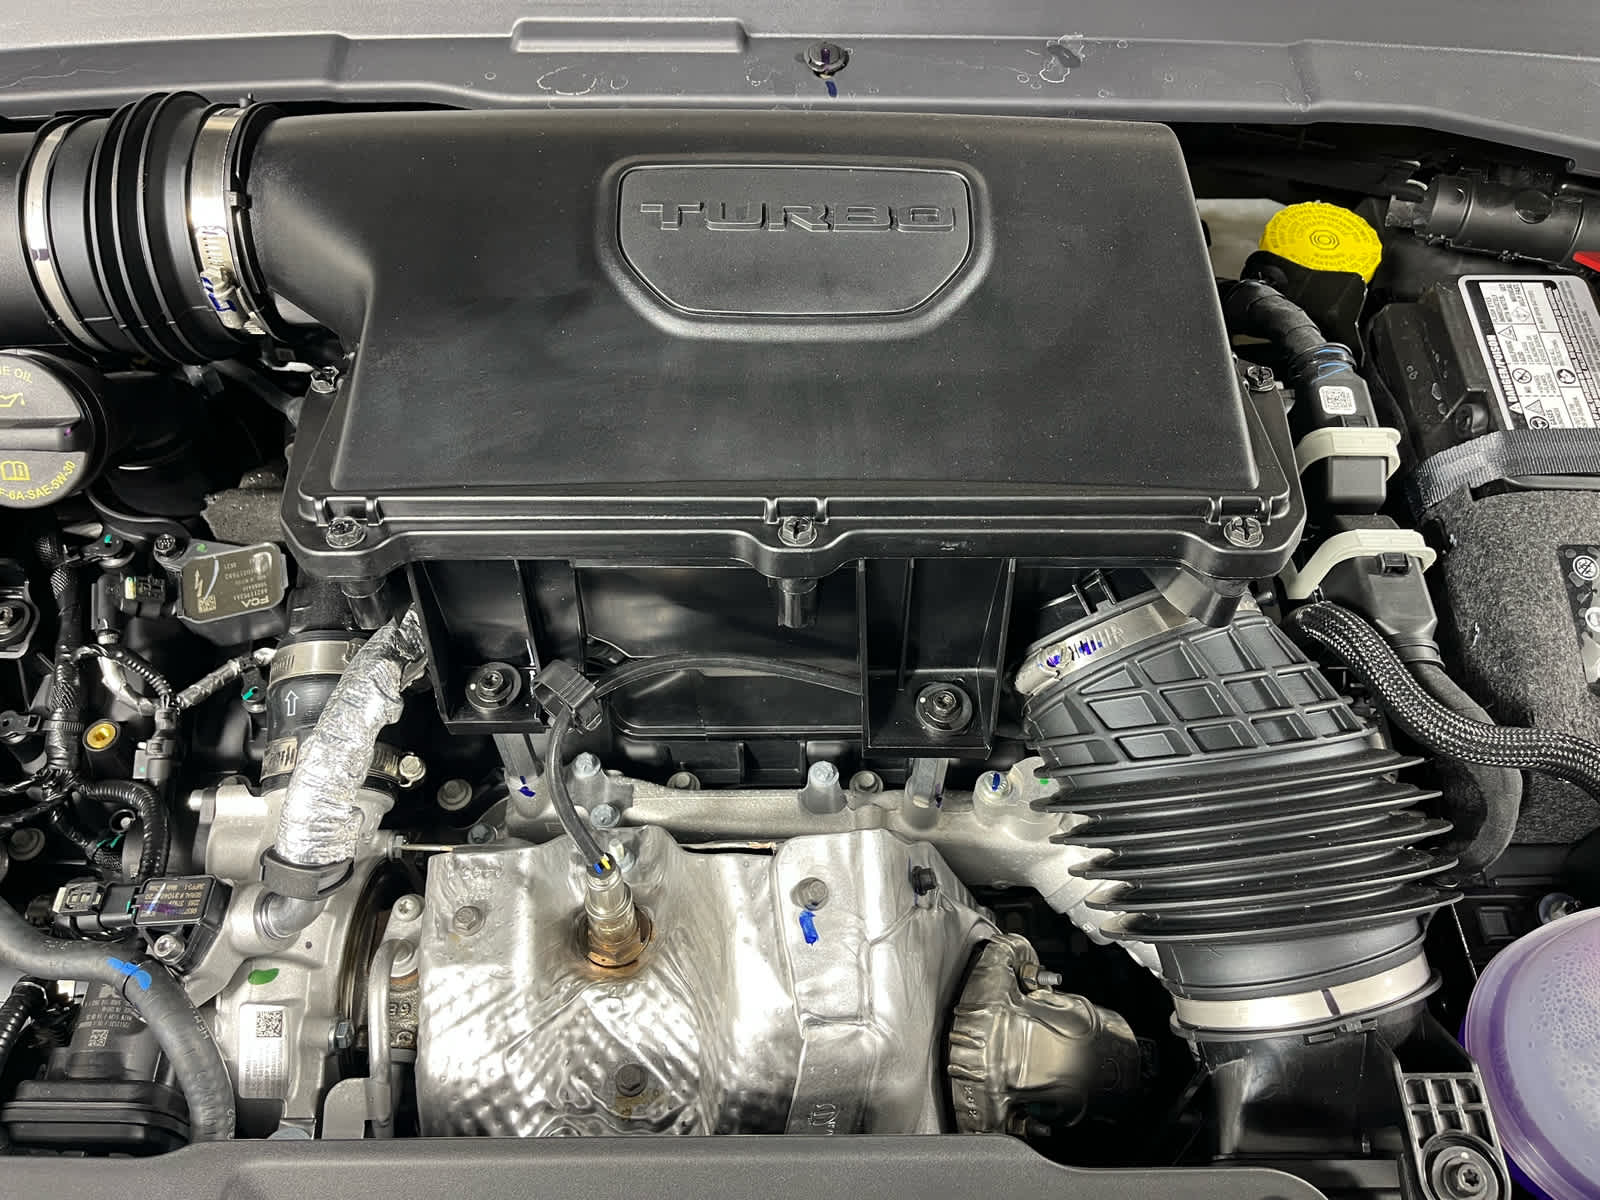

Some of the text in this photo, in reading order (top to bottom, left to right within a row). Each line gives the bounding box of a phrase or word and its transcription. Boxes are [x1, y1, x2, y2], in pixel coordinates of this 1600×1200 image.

[640, 203, 955, 232] TURBO
[14, 368, 33, 384] OIL
[1487, 334, 1518, 402] DANGER/POISON
[241, 596, 270, 609] FCA
